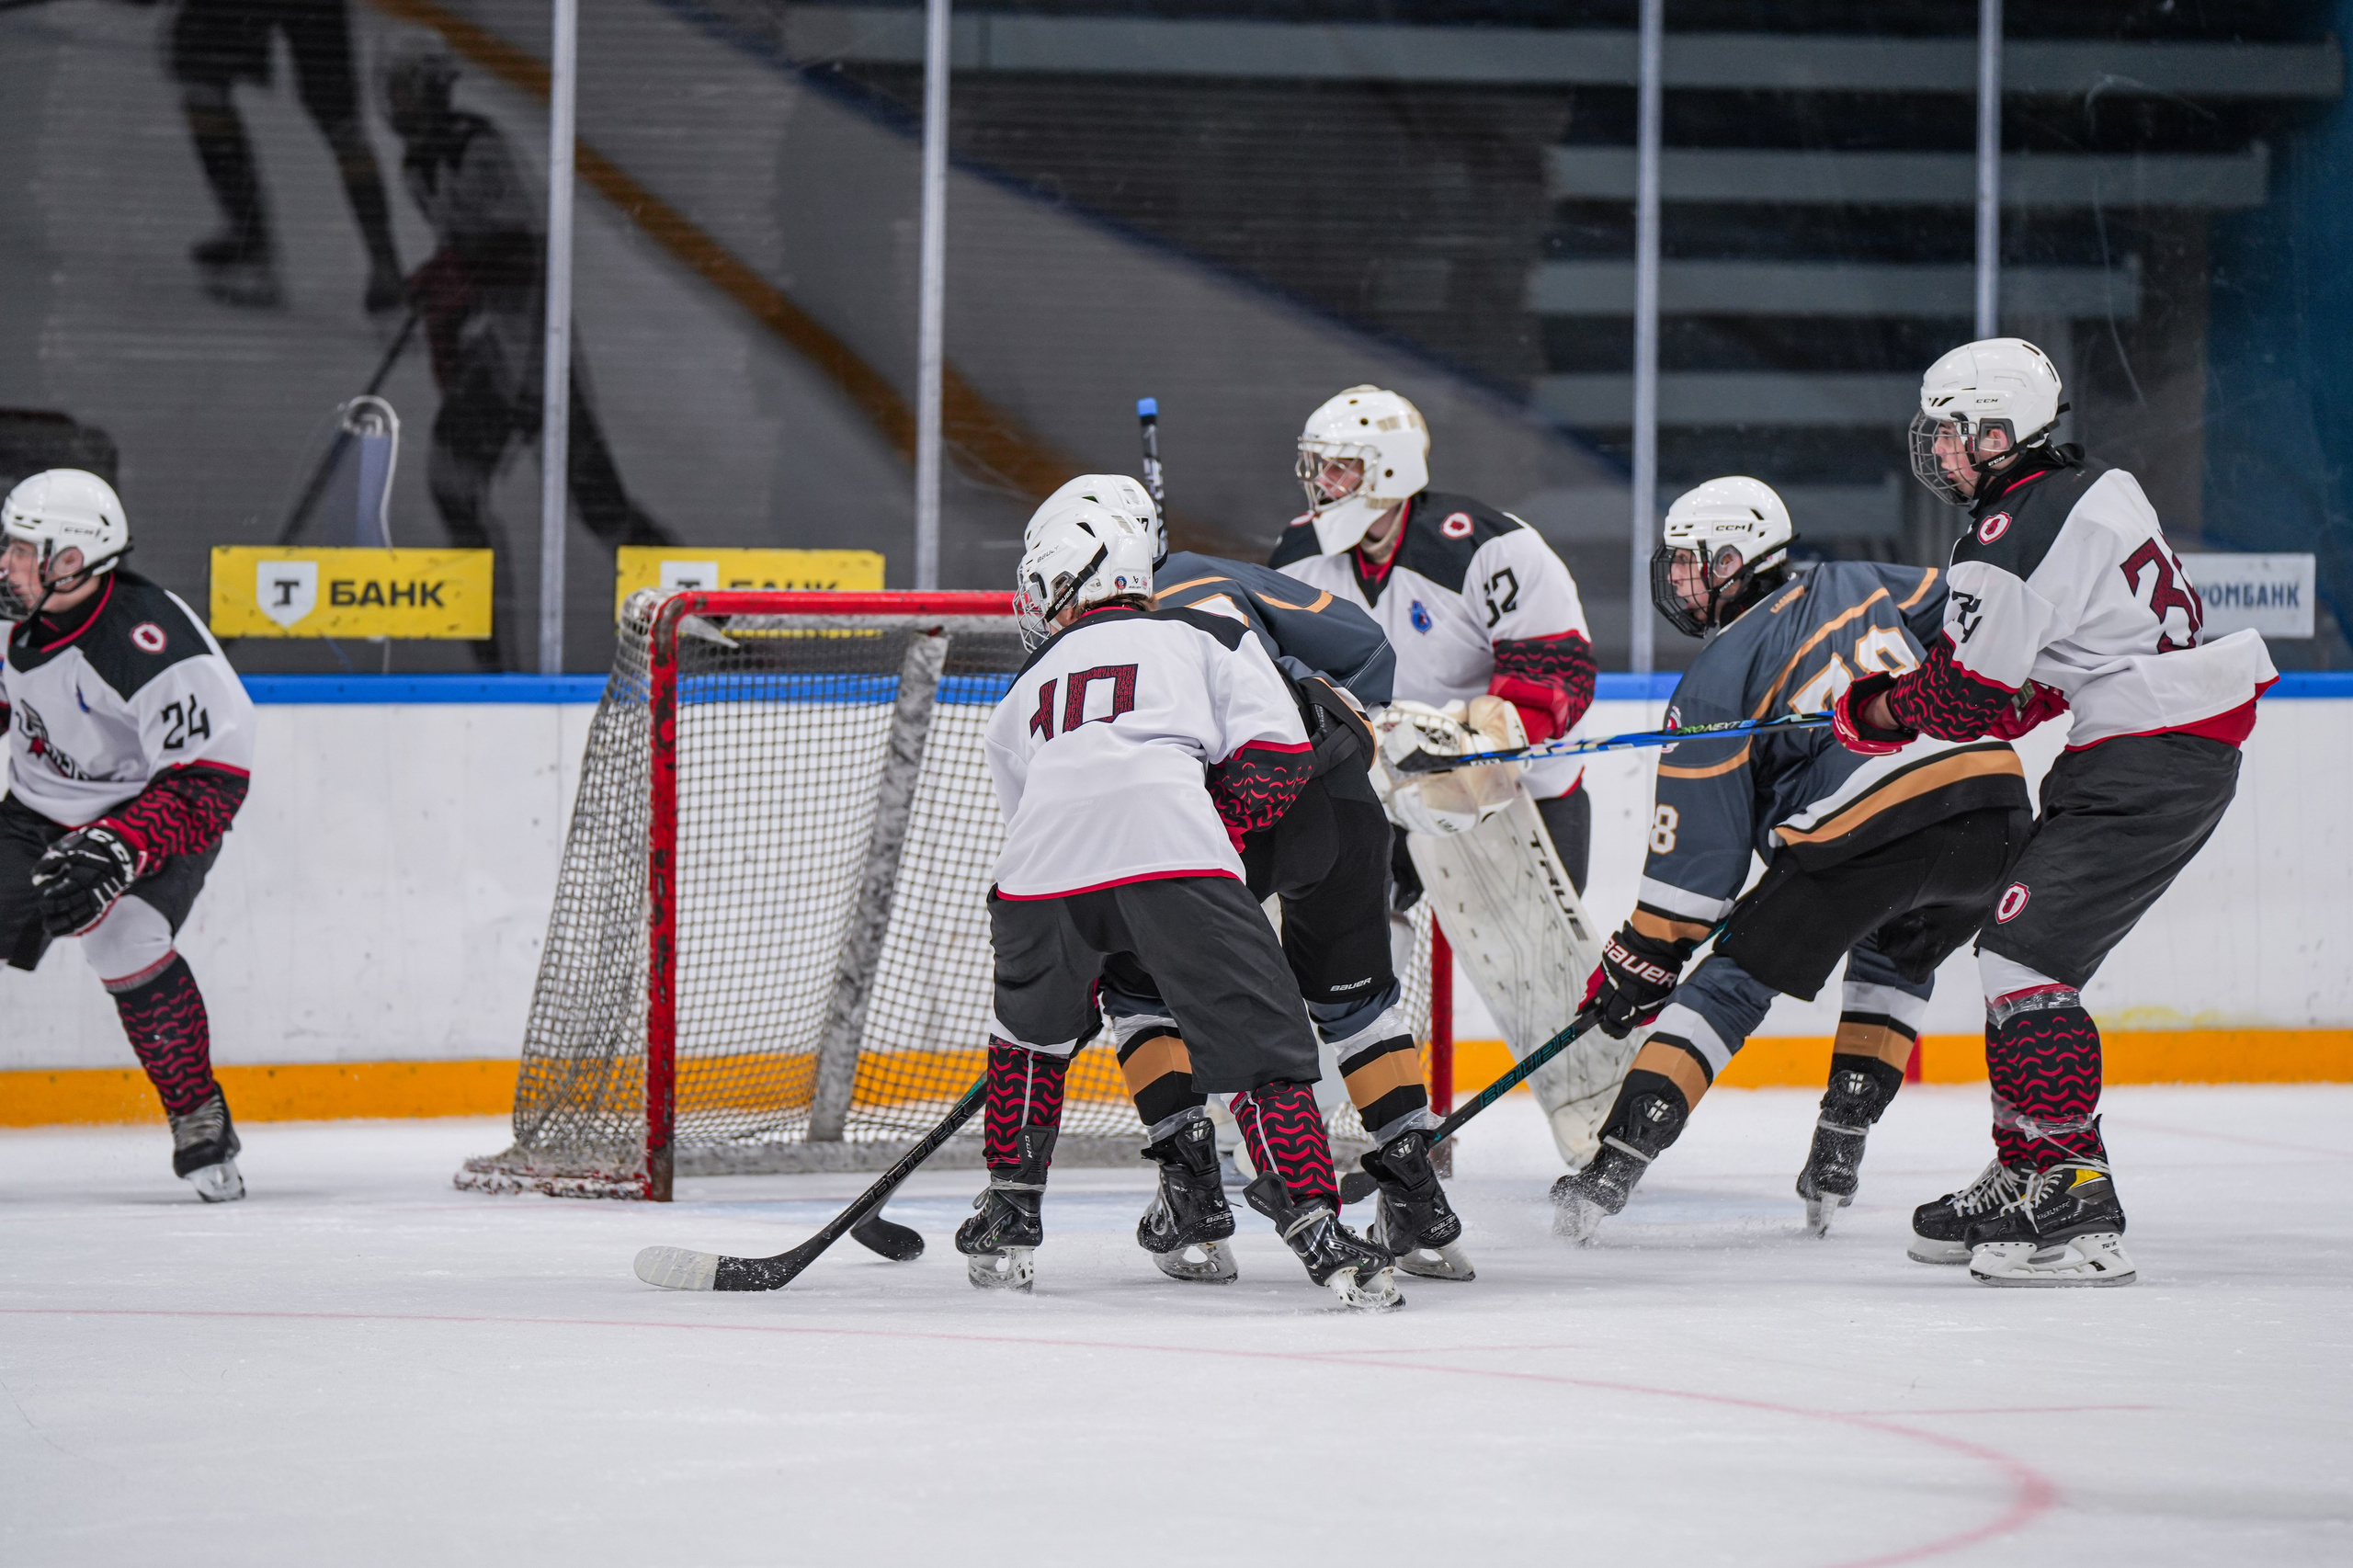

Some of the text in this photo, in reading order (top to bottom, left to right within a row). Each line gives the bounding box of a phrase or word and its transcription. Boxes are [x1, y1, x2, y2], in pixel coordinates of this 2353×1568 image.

[1988, 455, 2006, 467] CCM
[1136, 517, 1149, 533] 7
[330, 579, 446, 608] БАНК
[1054, 586, 1074, 610] BAUER
[1029, 664, 1139, 743] 10
[161, 693, 210, 750] 24
[1529, 830, 1589, 941] TRUE
[1329, 977, 1372, 992] BAUER
[1480, 1025, 1576, 1109] BAUER
[871, 1100, 971, 1201] BAUER
[1024, 1134, 1034, 1159] CCM
[2036, 1198, 2072, 1221] BAUER
